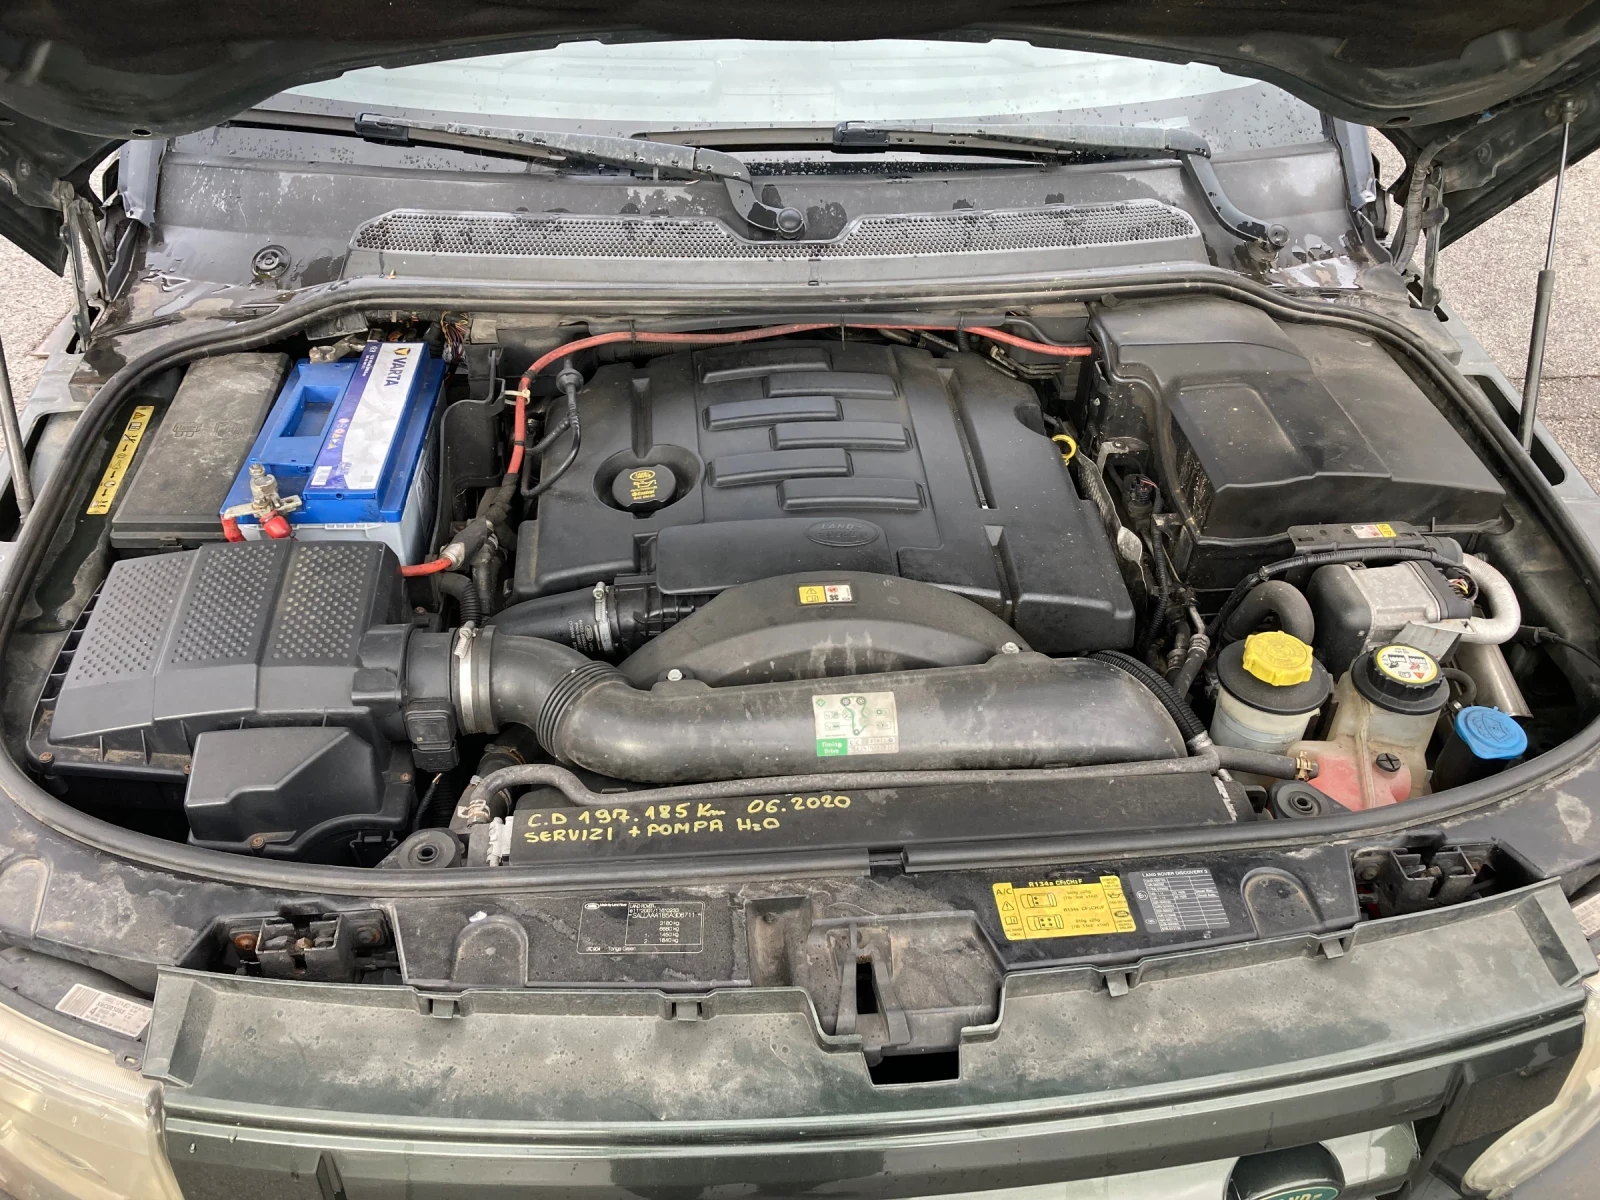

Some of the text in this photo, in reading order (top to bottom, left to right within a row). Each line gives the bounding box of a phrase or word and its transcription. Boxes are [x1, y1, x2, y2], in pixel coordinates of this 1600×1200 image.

[384, 357, 407, 387] VARTA
[747, 794, 851, 814] 06.2020
[524, 826, 613, 843] SERVIZI
[628, 825, 641, 838] +
[647, 818, 723, 837] POMPA
[996, 887, 1013, 895] A/C
